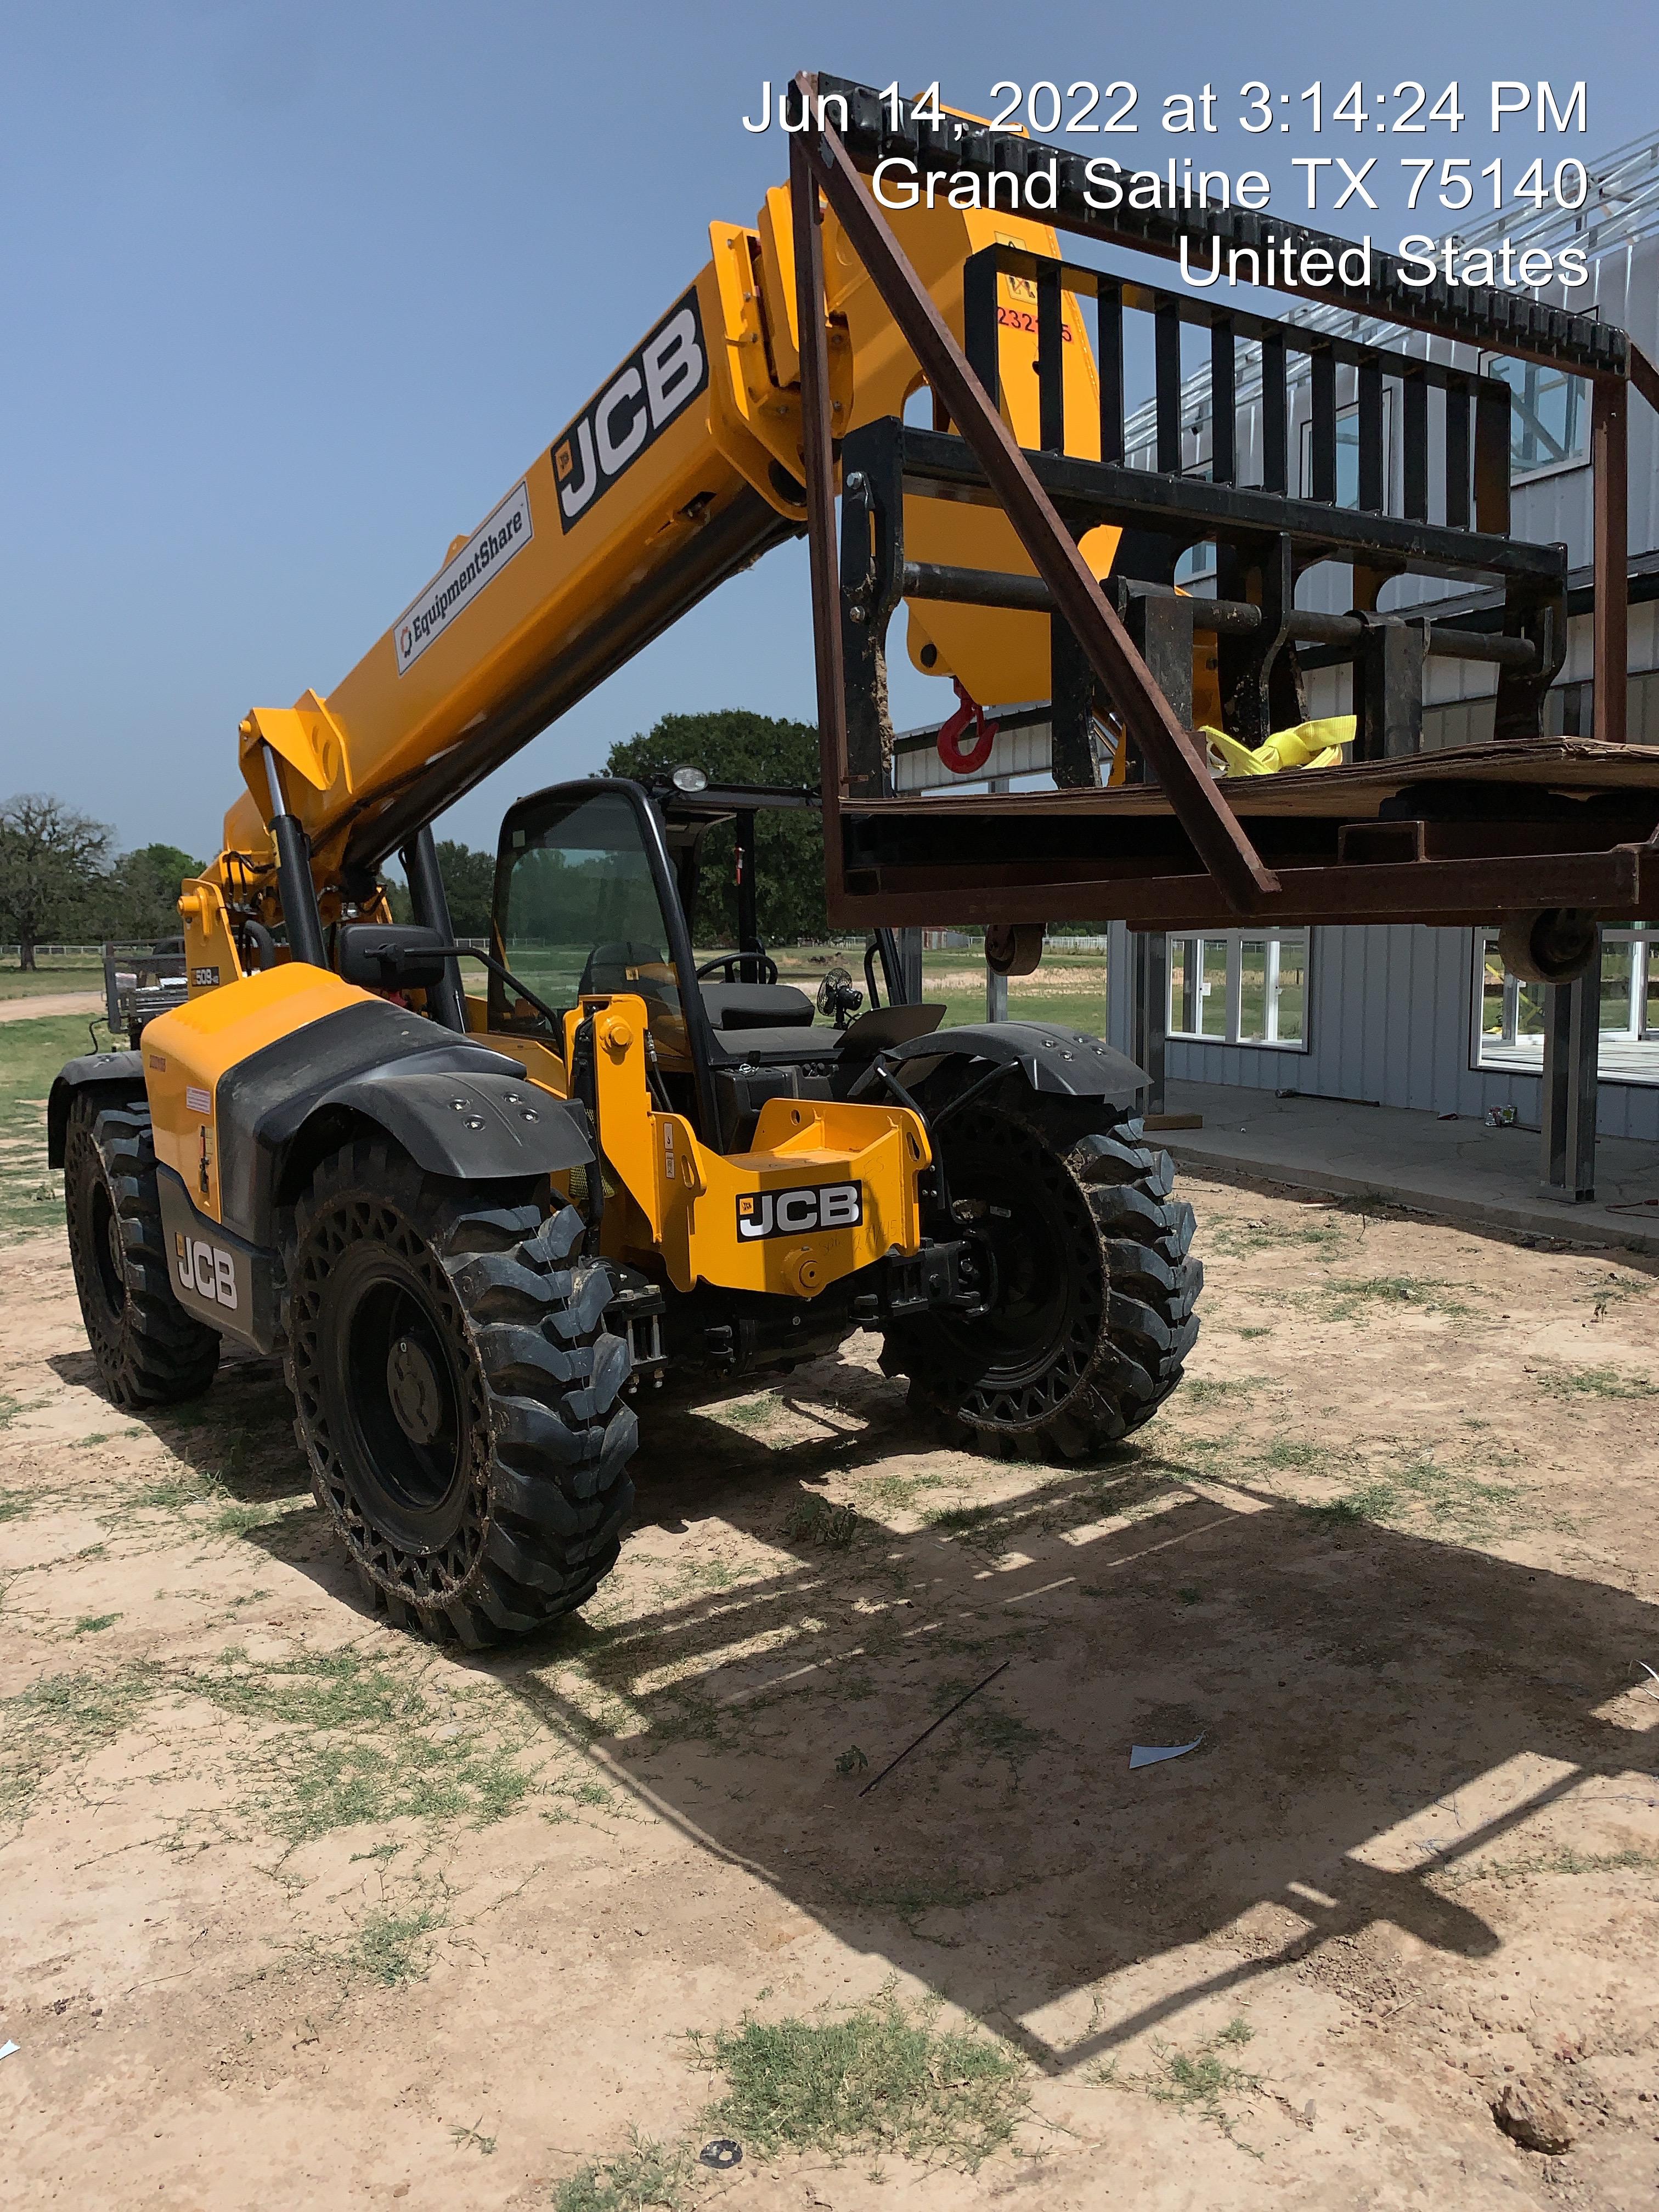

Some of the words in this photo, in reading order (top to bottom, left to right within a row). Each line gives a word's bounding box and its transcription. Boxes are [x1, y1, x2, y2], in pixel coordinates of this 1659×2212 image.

[997, 306, 1072, 342] 2325
[561, 308, 703, 517] JCB
[412, 511, 522, 642] EquipmentShare
[740, 1186, 860, 1237] JCB
[178, 1236, 238, 1310] JCB
